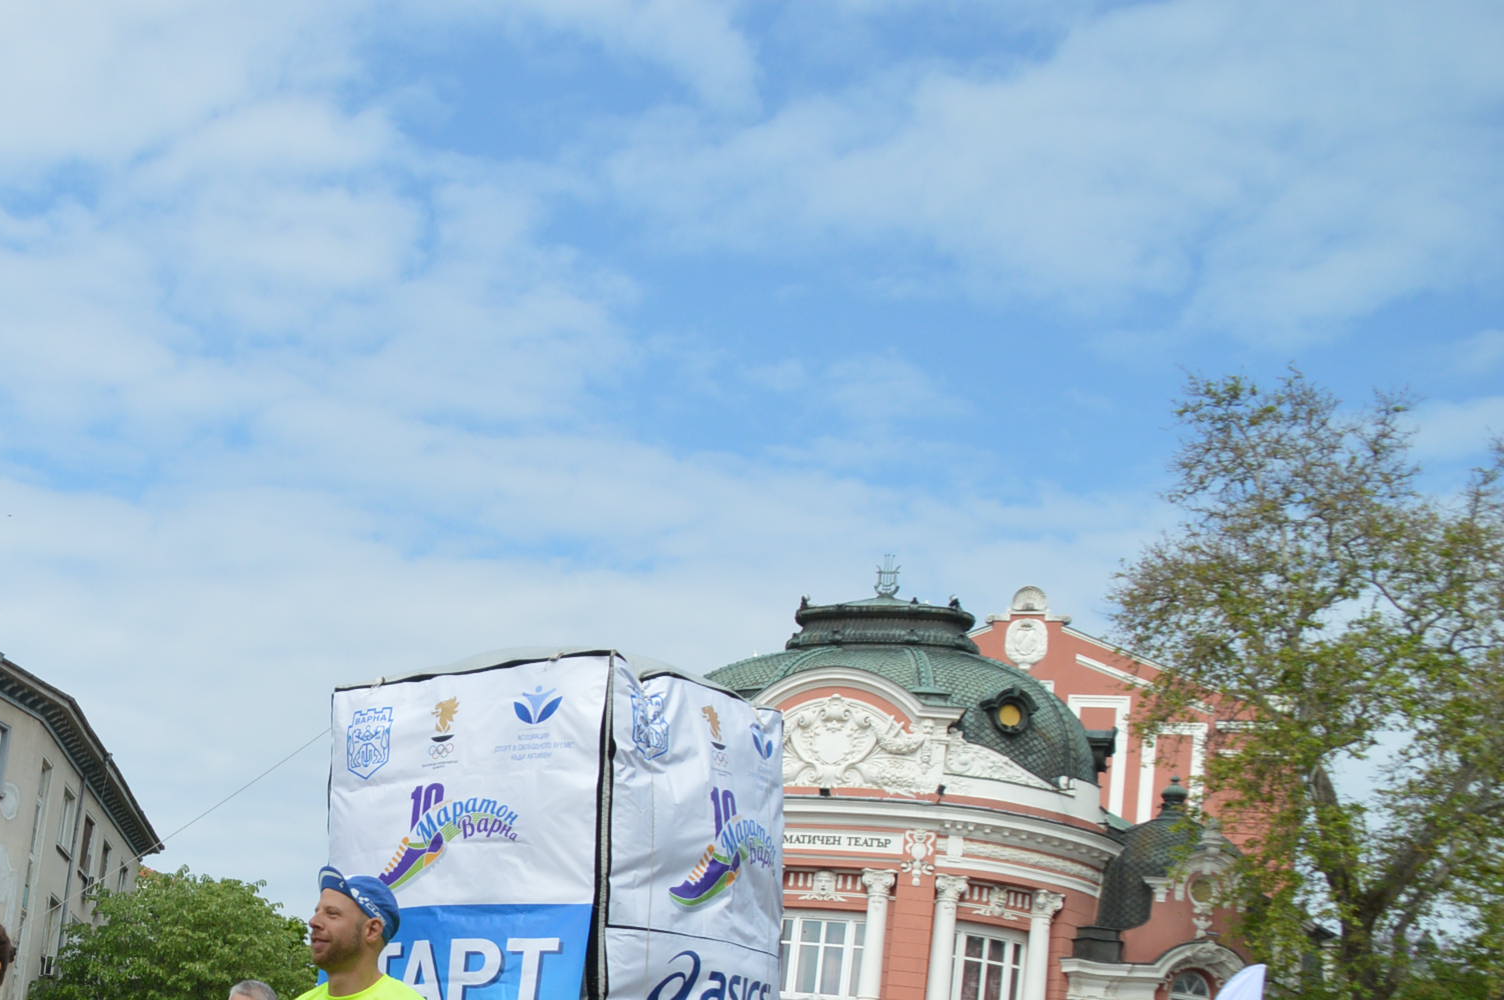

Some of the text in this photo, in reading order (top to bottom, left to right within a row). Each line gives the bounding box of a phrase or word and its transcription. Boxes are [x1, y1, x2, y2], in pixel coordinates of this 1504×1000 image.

[355, 713, 387, 725] ВАРНА
[410, 782, 445, 832] 10
[416, 797, 519, 846] Маратон
[710, 787, 736, 840] 10
[458, 815, 518, 842] Варна
[783, 834, 892, 848] МАТИЧЕН ТЕАТЪР
